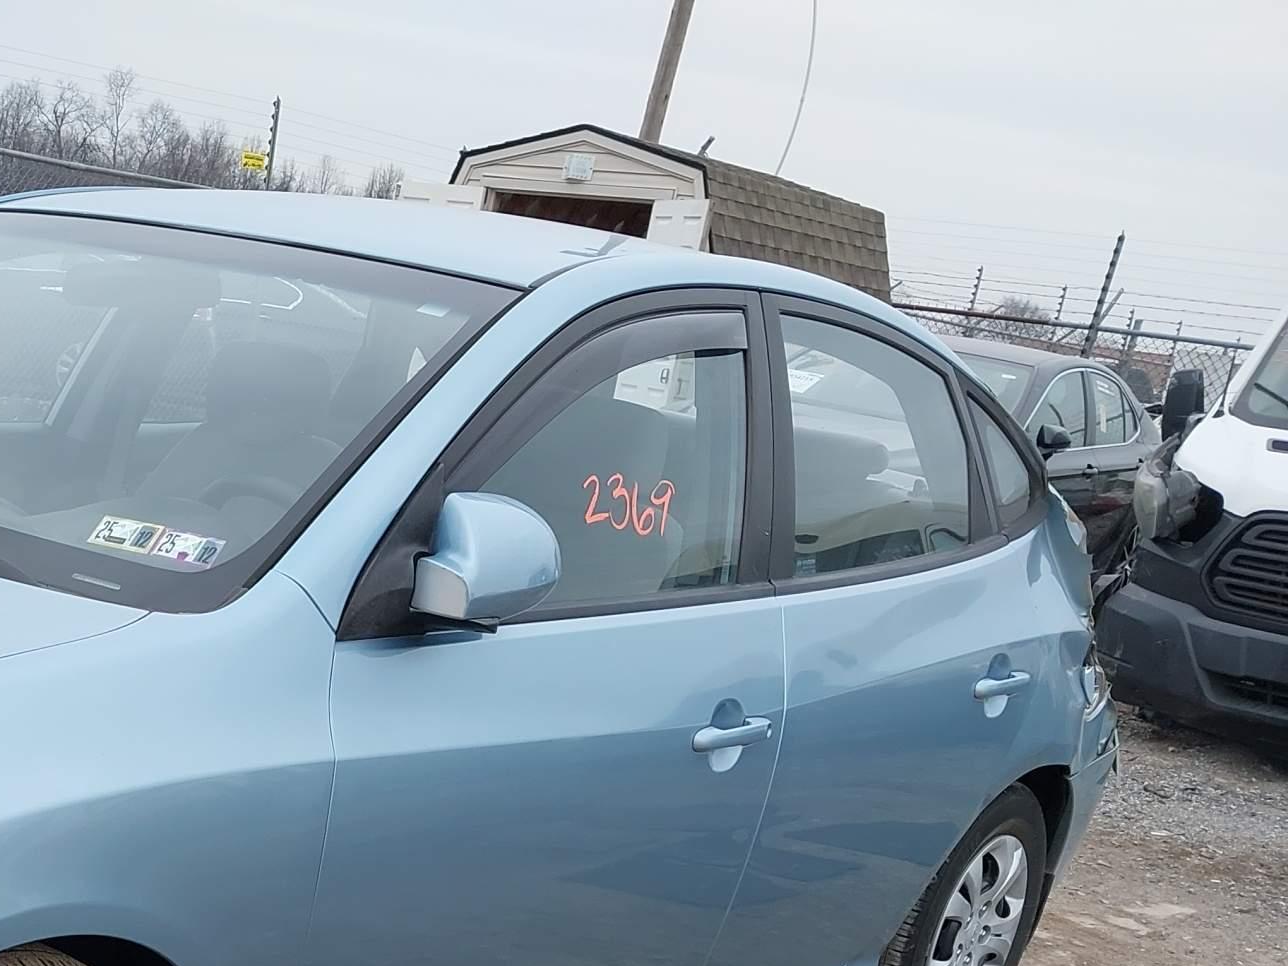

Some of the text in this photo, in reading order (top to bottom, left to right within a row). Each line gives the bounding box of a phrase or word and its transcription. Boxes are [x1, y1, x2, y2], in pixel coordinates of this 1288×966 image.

[583, 472, 675, 536] 2369
[158, 533, 217, 564] 25 12
